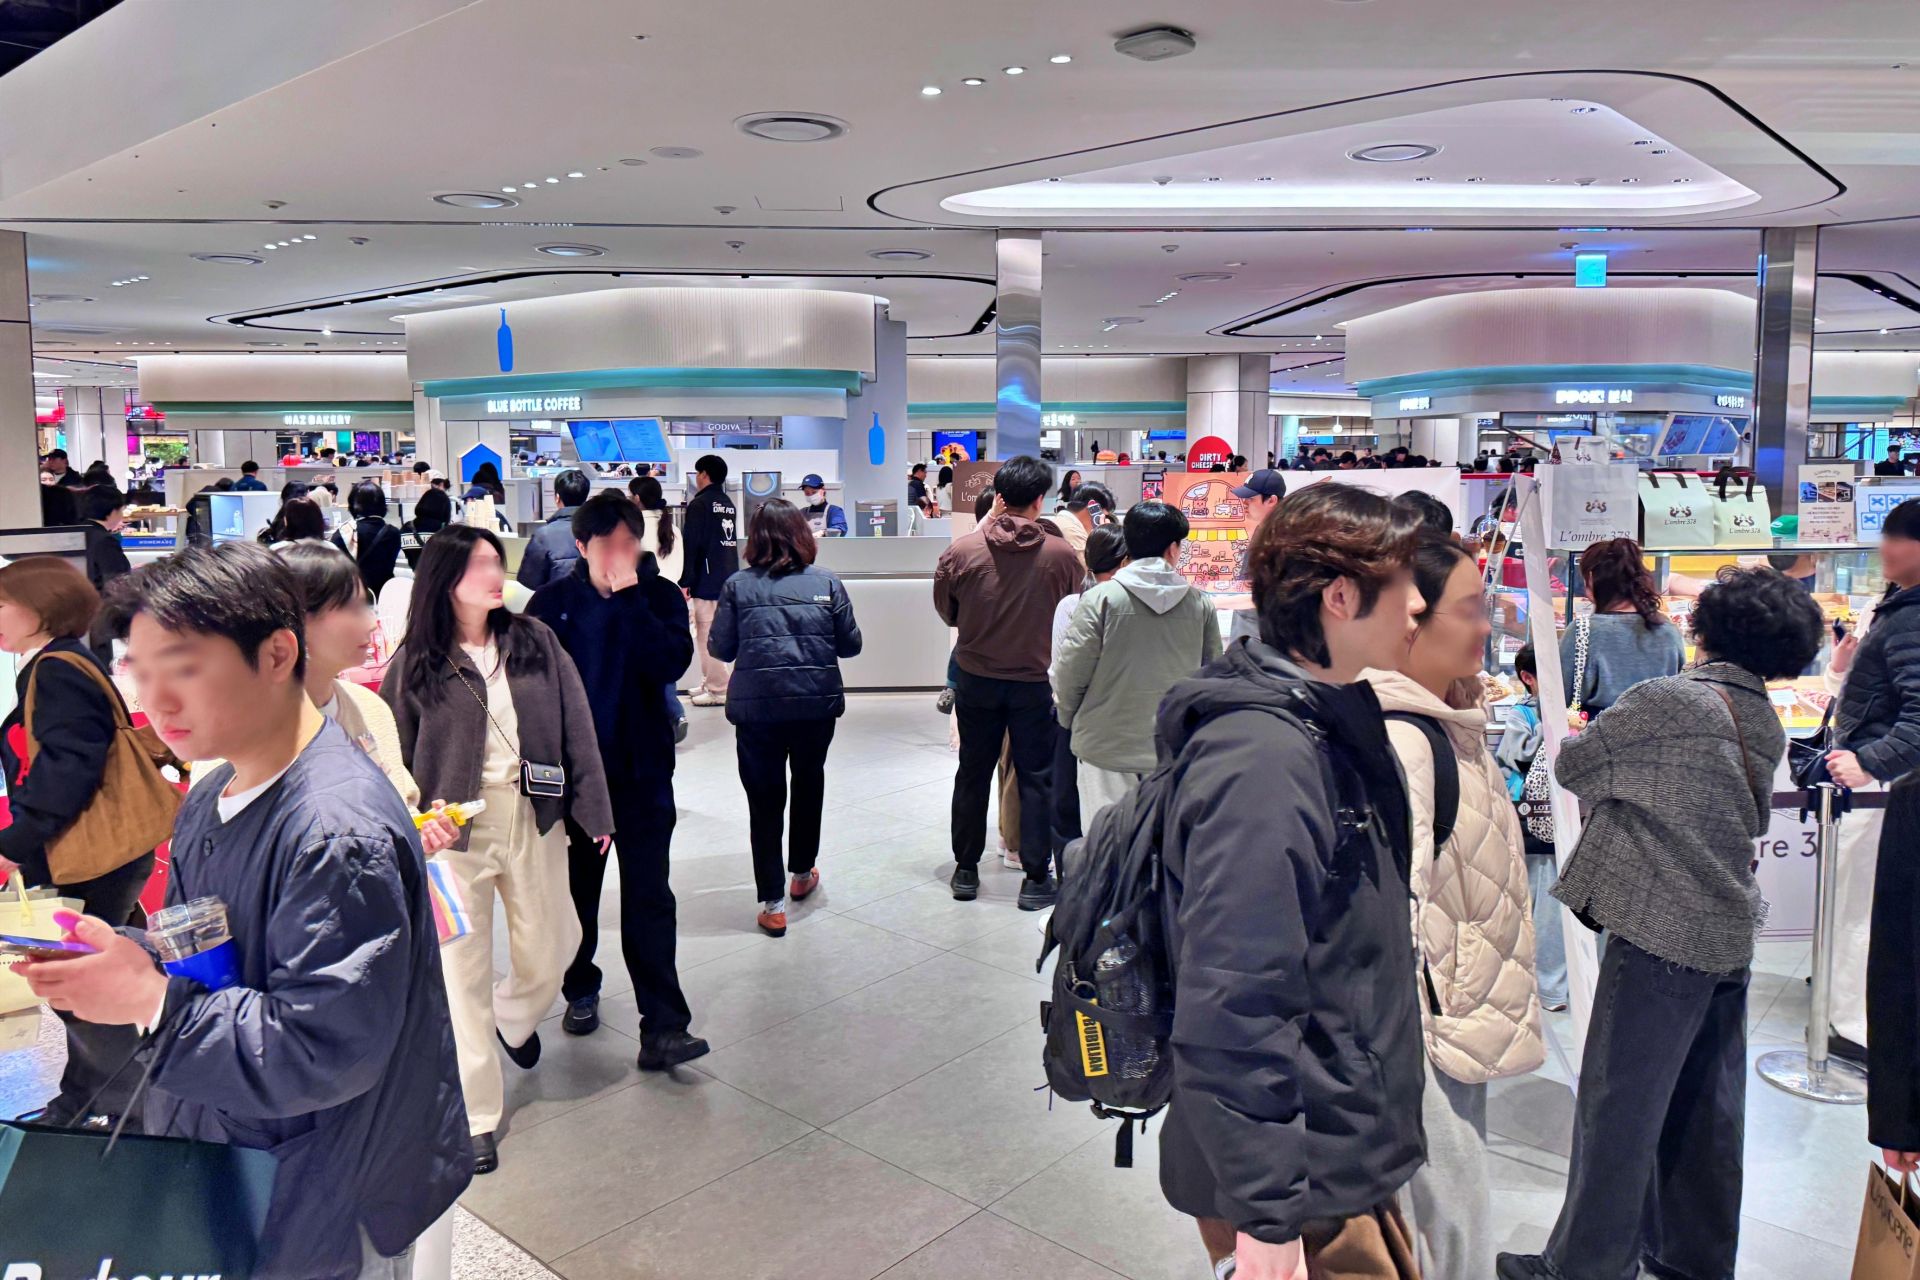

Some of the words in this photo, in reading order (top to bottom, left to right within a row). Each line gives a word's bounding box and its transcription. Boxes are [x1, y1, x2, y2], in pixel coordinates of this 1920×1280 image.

[487, 399, 509, 413] BLUE
[509, 398, 543, 412] BOTTLE
[543, 396, 581, 411] COFFEE
[307, 414, 352, 425] BAKERY
[708, 423, 740, 431] GODIVA
[1199, 452, 1222, 462] DIRTY
[1559, 530, 1607, 542] L'ombre
